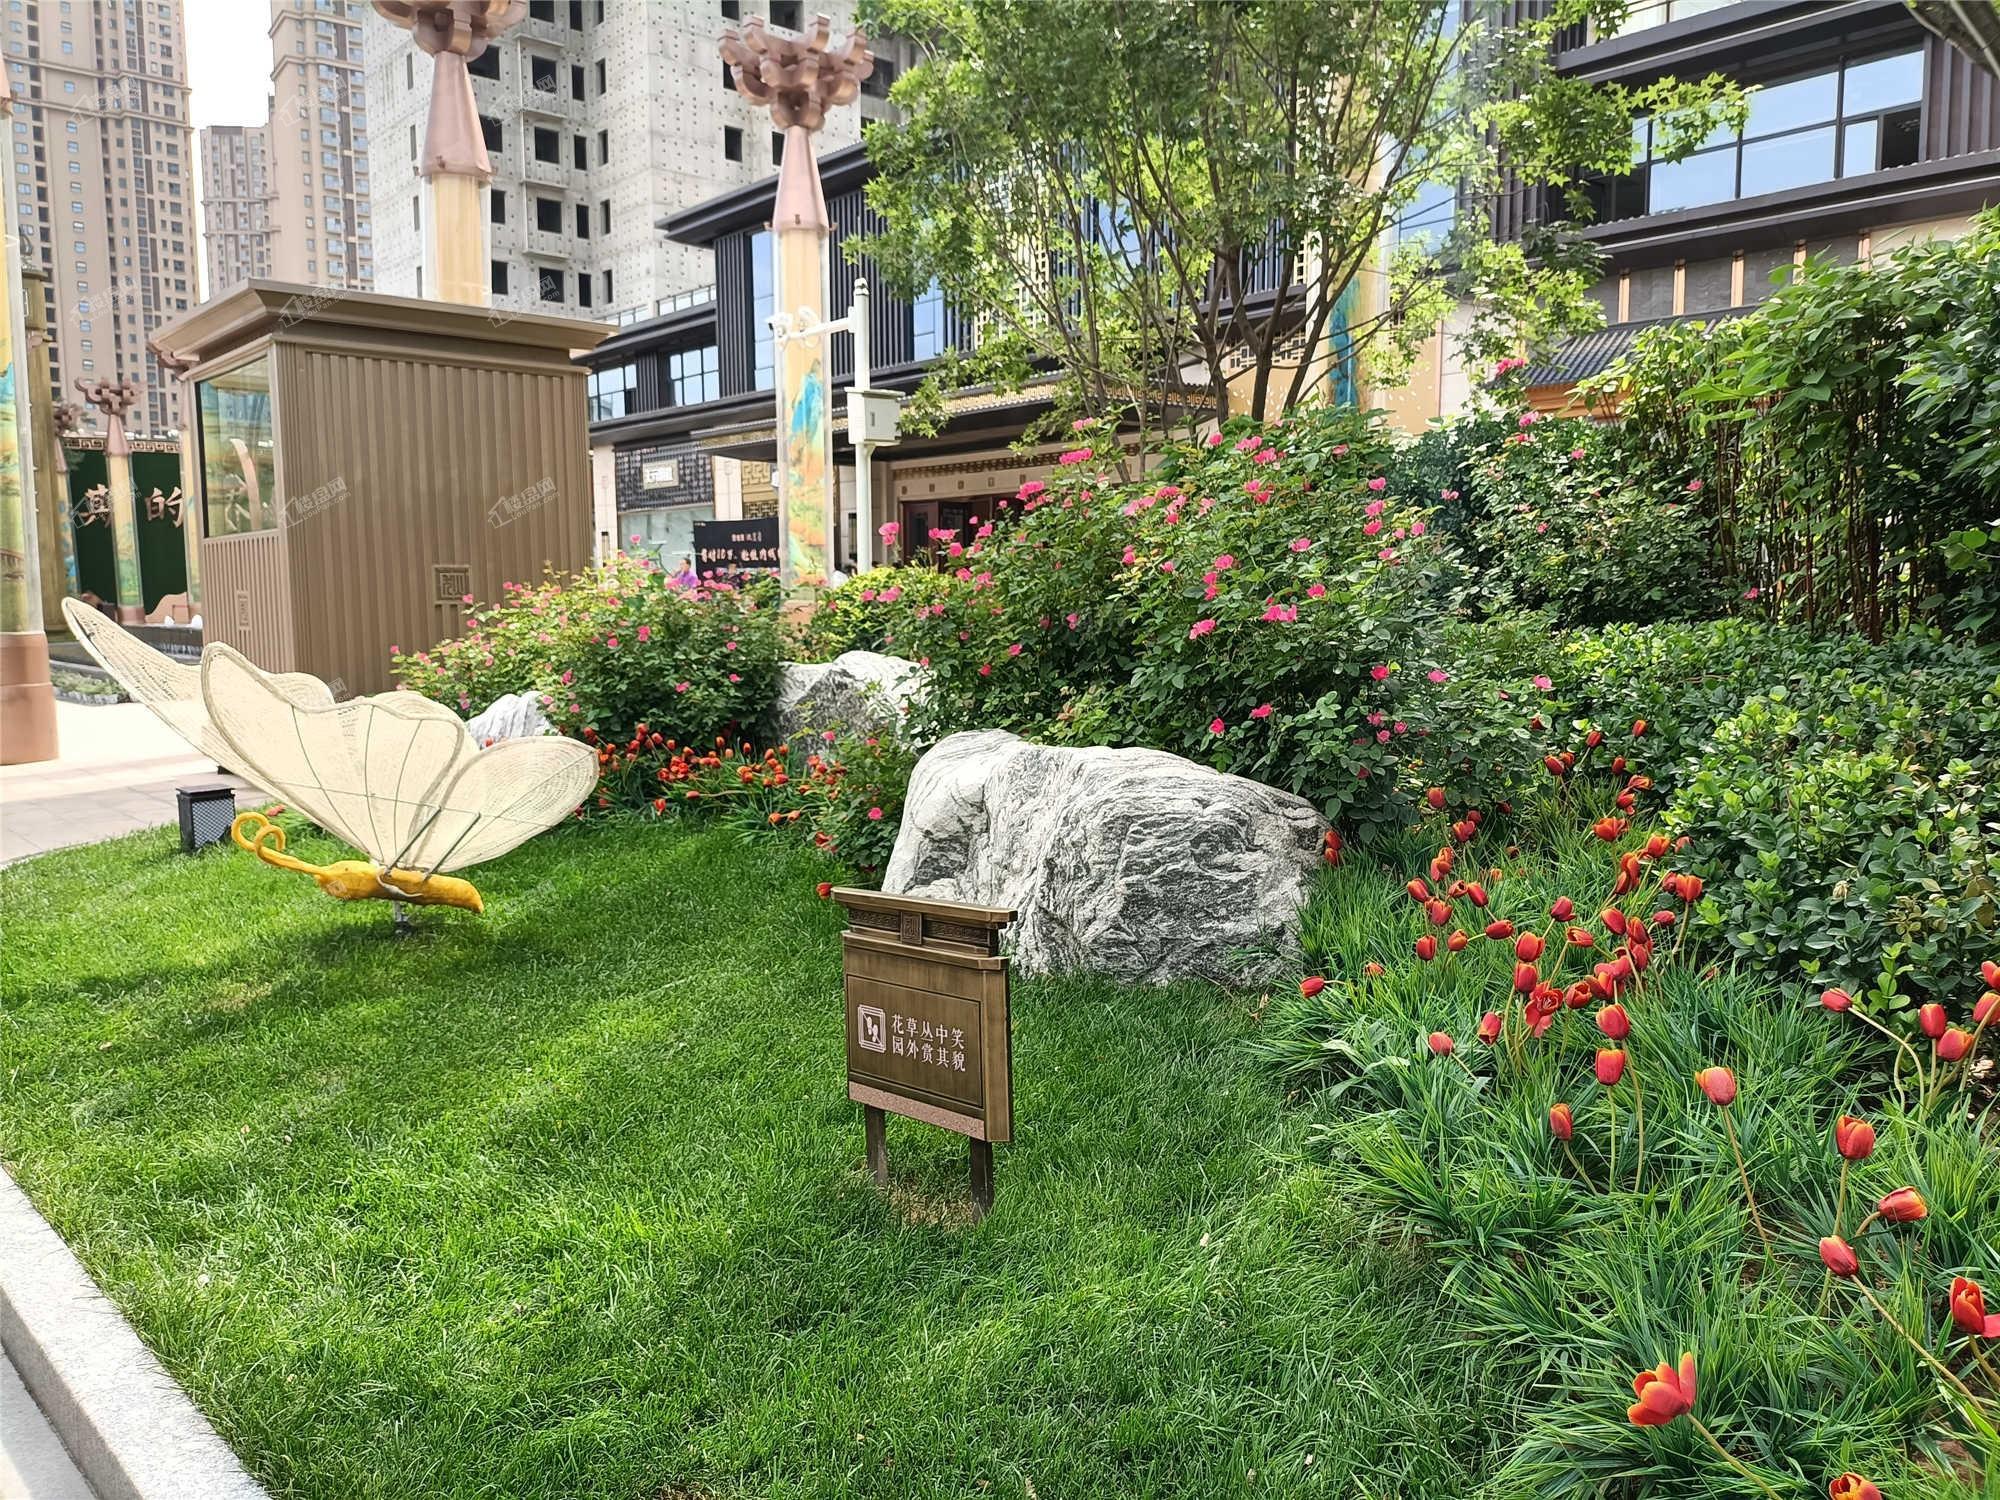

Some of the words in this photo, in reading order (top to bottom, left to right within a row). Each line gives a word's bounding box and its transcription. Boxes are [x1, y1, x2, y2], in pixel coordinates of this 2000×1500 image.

[891, 1014, 964, 1049] 花草丛中笑
[892, 1036, 966, 1072] 园外赏其貌
